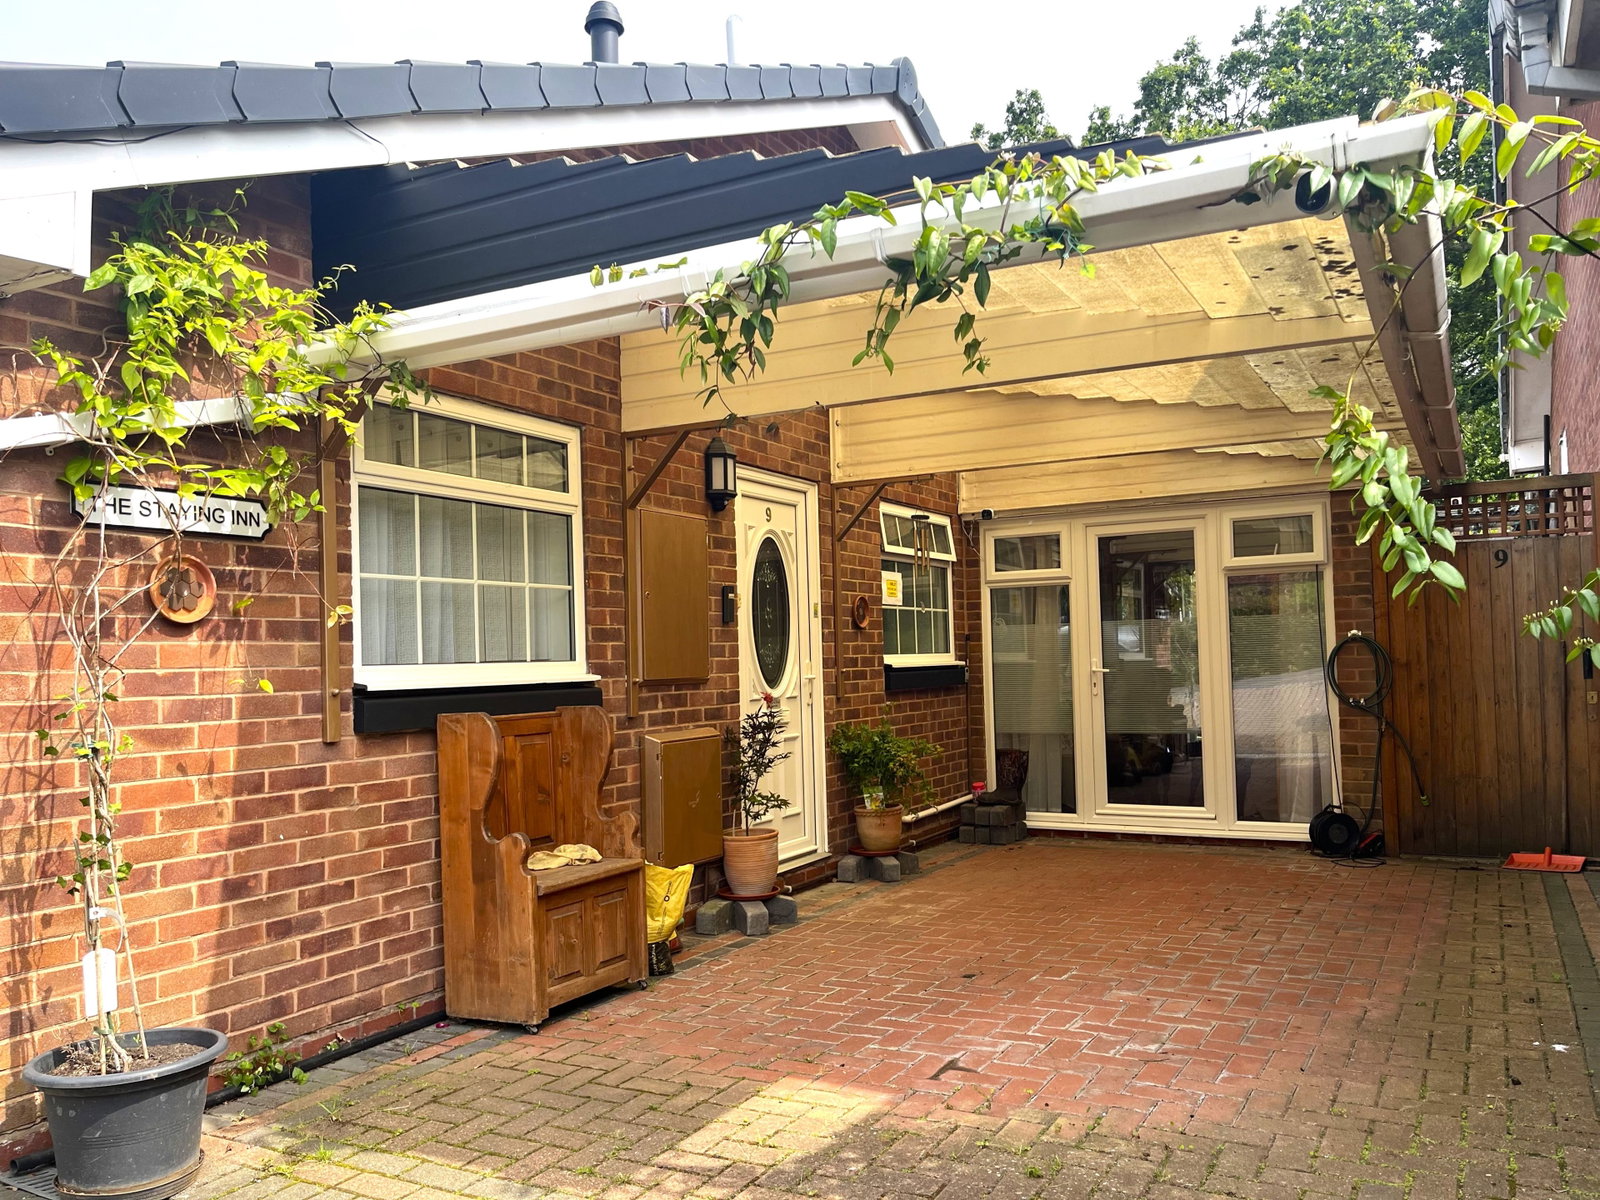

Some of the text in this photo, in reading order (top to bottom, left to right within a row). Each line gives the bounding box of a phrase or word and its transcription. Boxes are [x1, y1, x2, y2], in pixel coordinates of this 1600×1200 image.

[91, 495, 260, 528] THE STAYING INN
[765, 507, 772, 523] 9
[1494, 549, 1509, 569] 9
